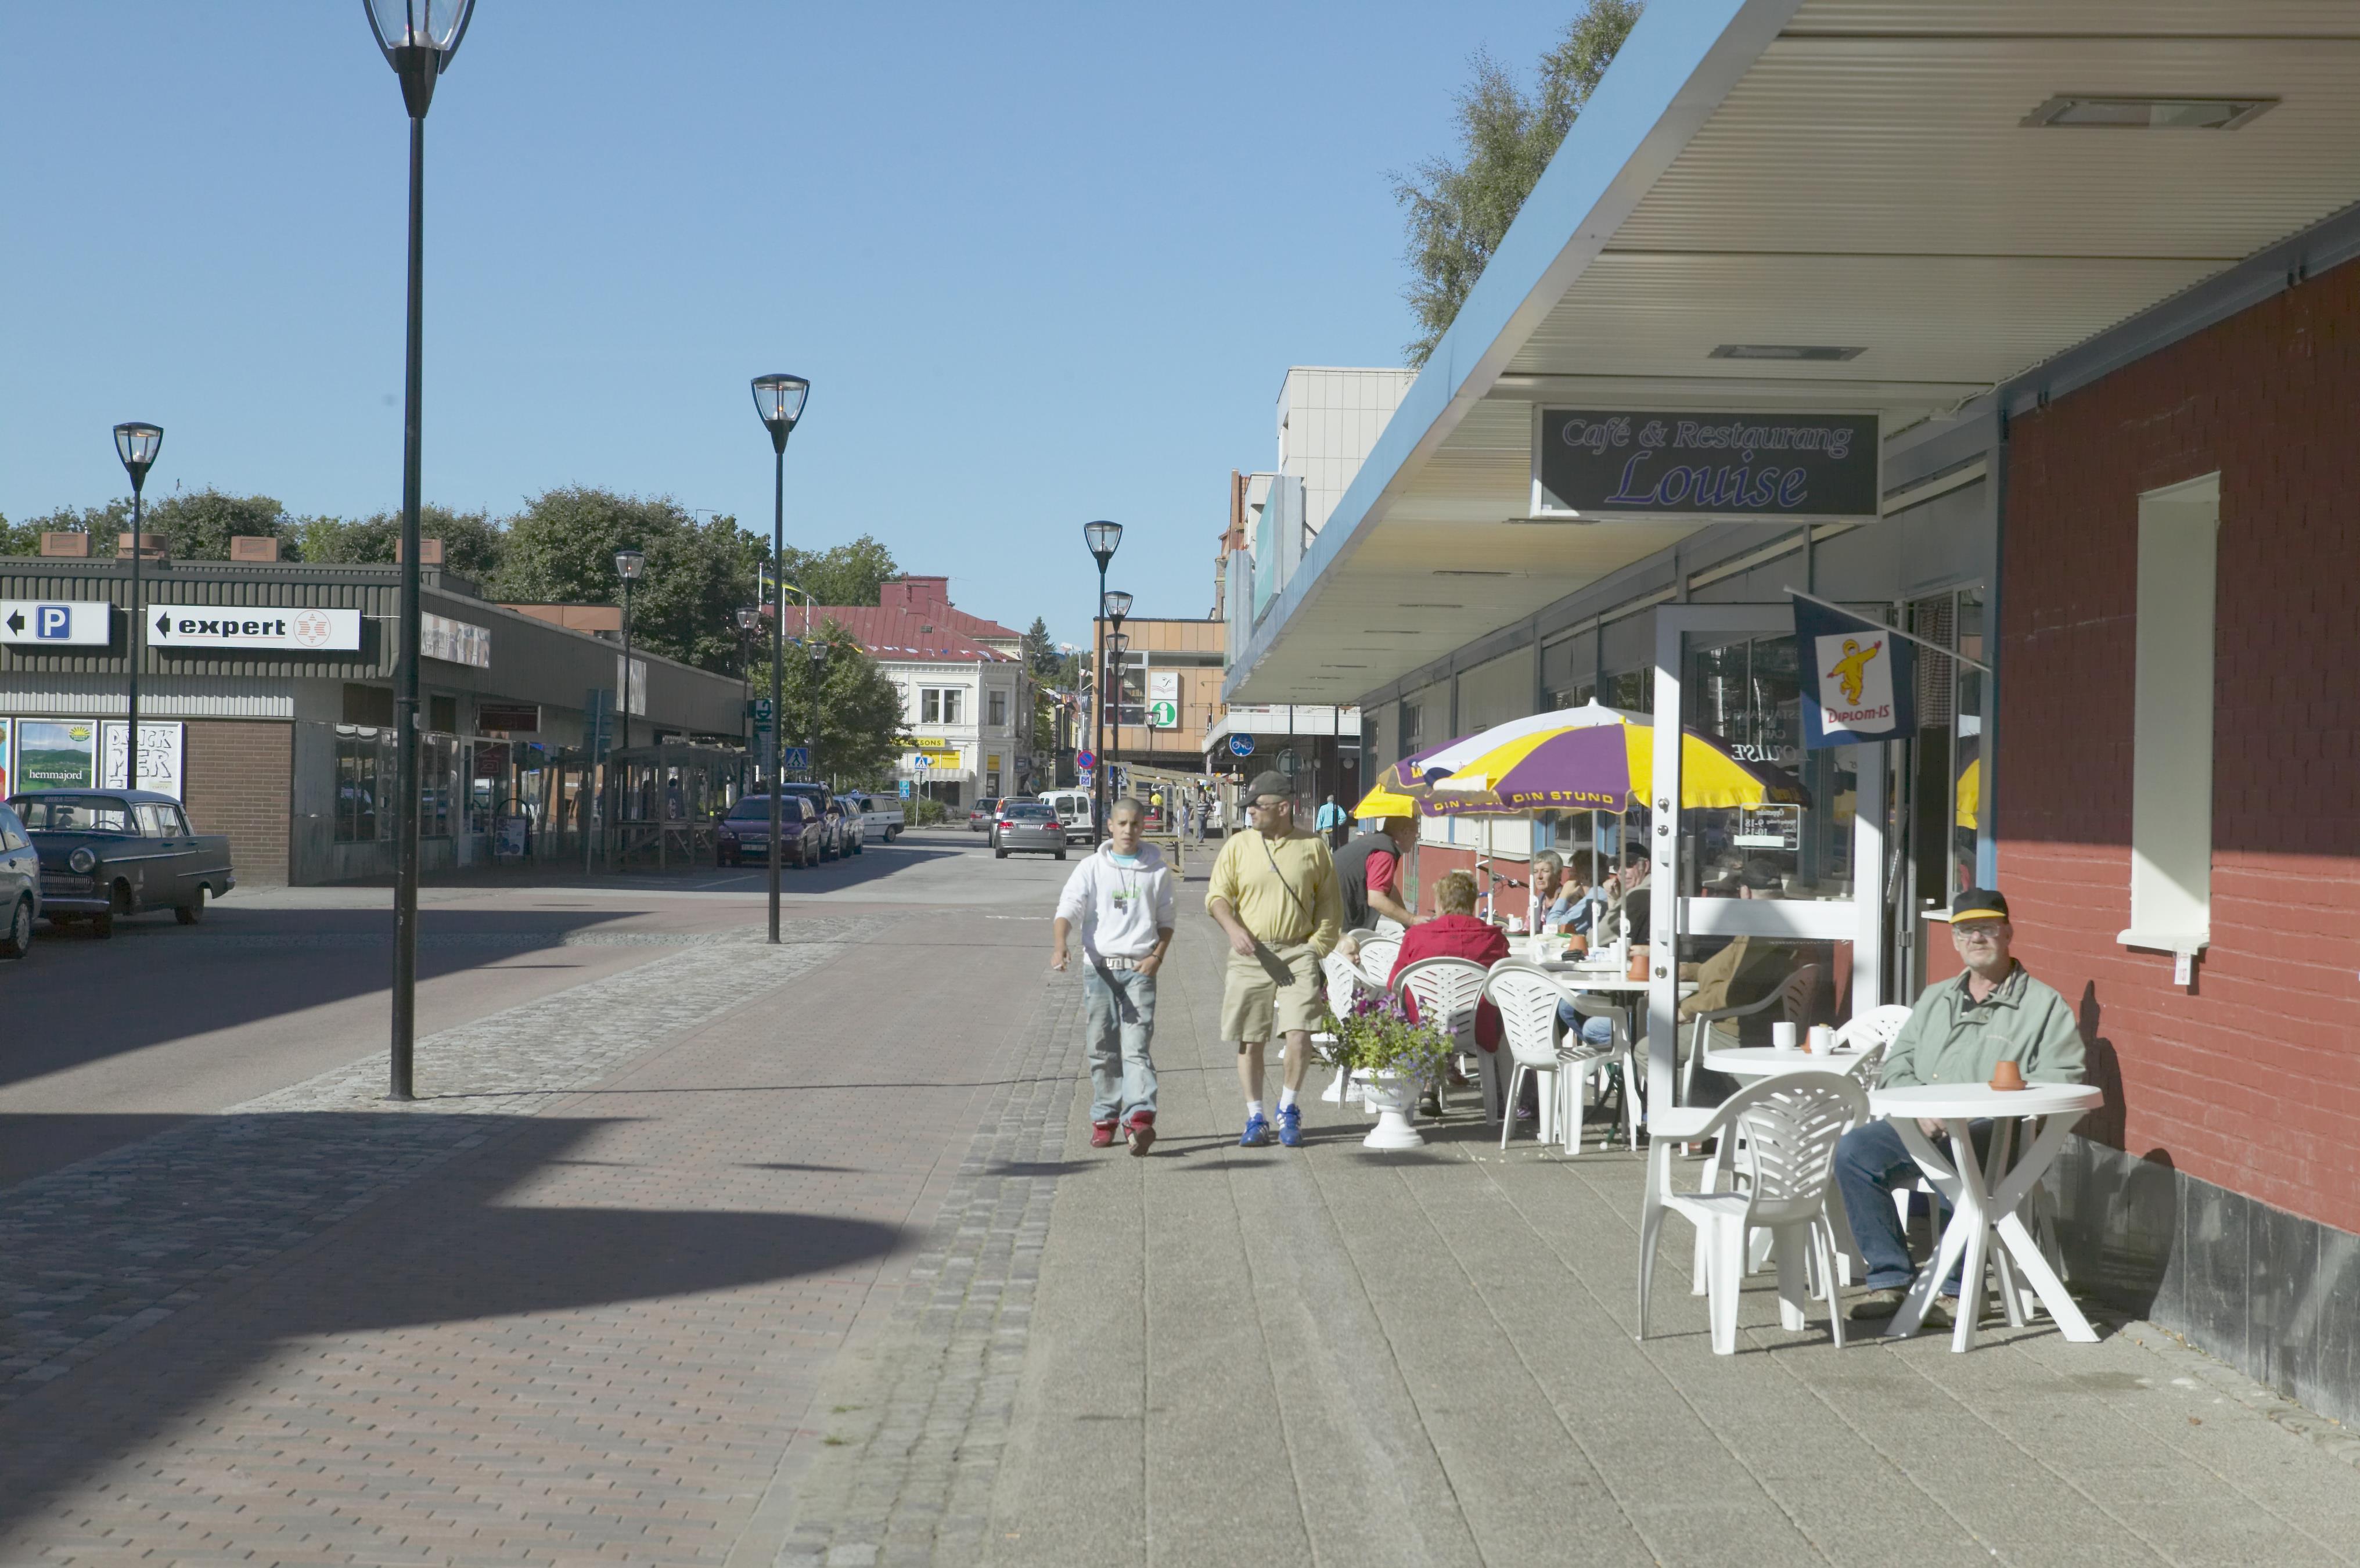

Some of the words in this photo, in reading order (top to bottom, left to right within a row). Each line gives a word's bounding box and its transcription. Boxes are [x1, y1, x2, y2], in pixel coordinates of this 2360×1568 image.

[1562, 416, 1631, 455] Café
[1638, 420, 1667, 447] &
[1674, 420, 1854, 459] Restaurang
[1603, 449, 1808, 508] Louise
[44, 609, 66, 636] P
[178, 618, 286, 639] expert
[29, 769, 82, 781] hemmajord
[1433, 800, 1460, 811] DIN
[1512, 792, 1544, 803] DIN
[1550, 792, 1614, 804] STUND
